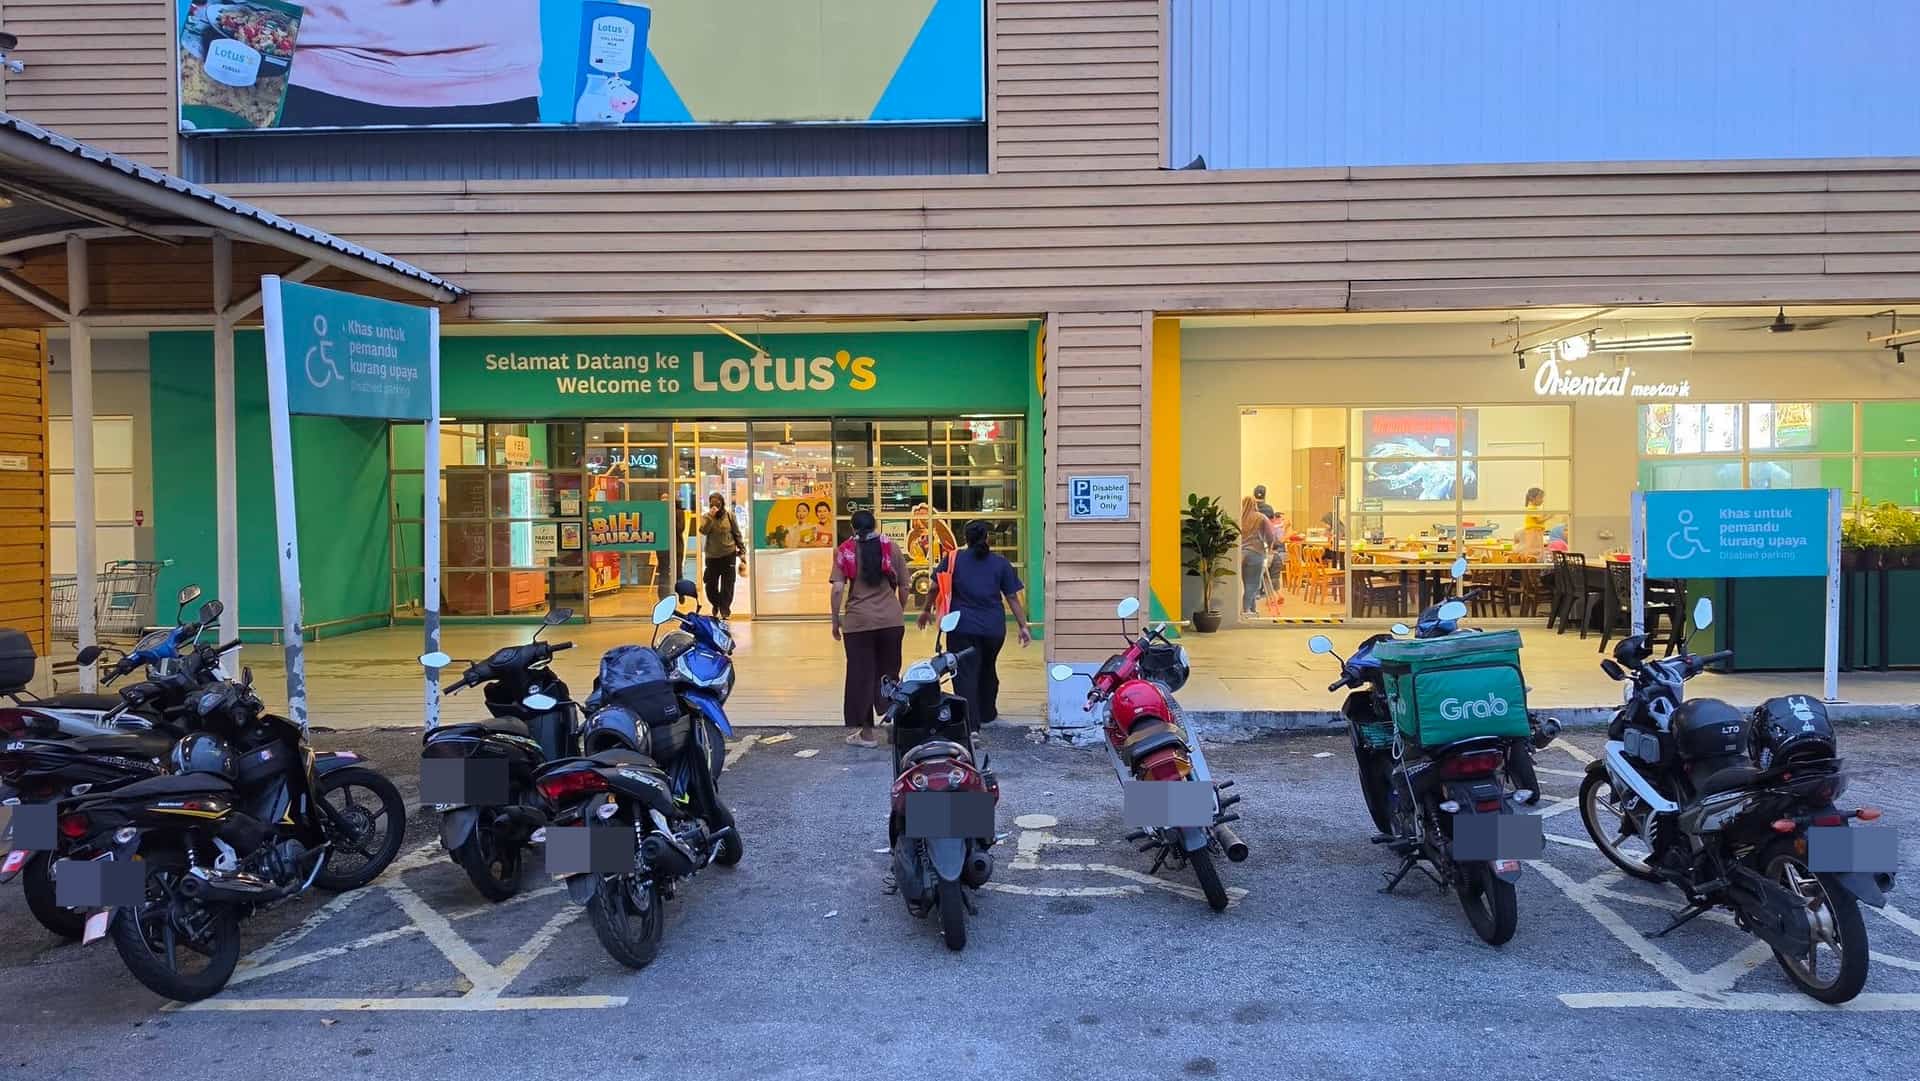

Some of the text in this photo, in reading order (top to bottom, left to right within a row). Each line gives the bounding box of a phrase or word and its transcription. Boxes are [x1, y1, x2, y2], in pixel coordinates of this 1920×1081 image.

[598, 23, 629, 34] Lotus'
[348, 319, 405, 342] Khas untuk
[349, 341, 398, 359] pemandu
[350, 358, 418, 383] kurang upaya
[485, 352, 679, 374] Selamat Datang ke
[692, 350, 877, 392] Lotus's
[1534, 350, 1630, 396] Oriental
[556, 376, 680, 394] Welcome to
[1093, 484, 1124, 492] Disabled
[1100, 502, 1118, 510] Only
[1719, 507, 1793, 519] Khas untuk
[588, 512, 641, 535] BIH
[1719, 521, 1780, 534] pemandu
[591, 531, 655, 545] MURAH
[1719, 535, 1808, 549] kurang upaya
[1761, 550, 1796, 562] parking
[1439, 692, 1508, 721] Grab
